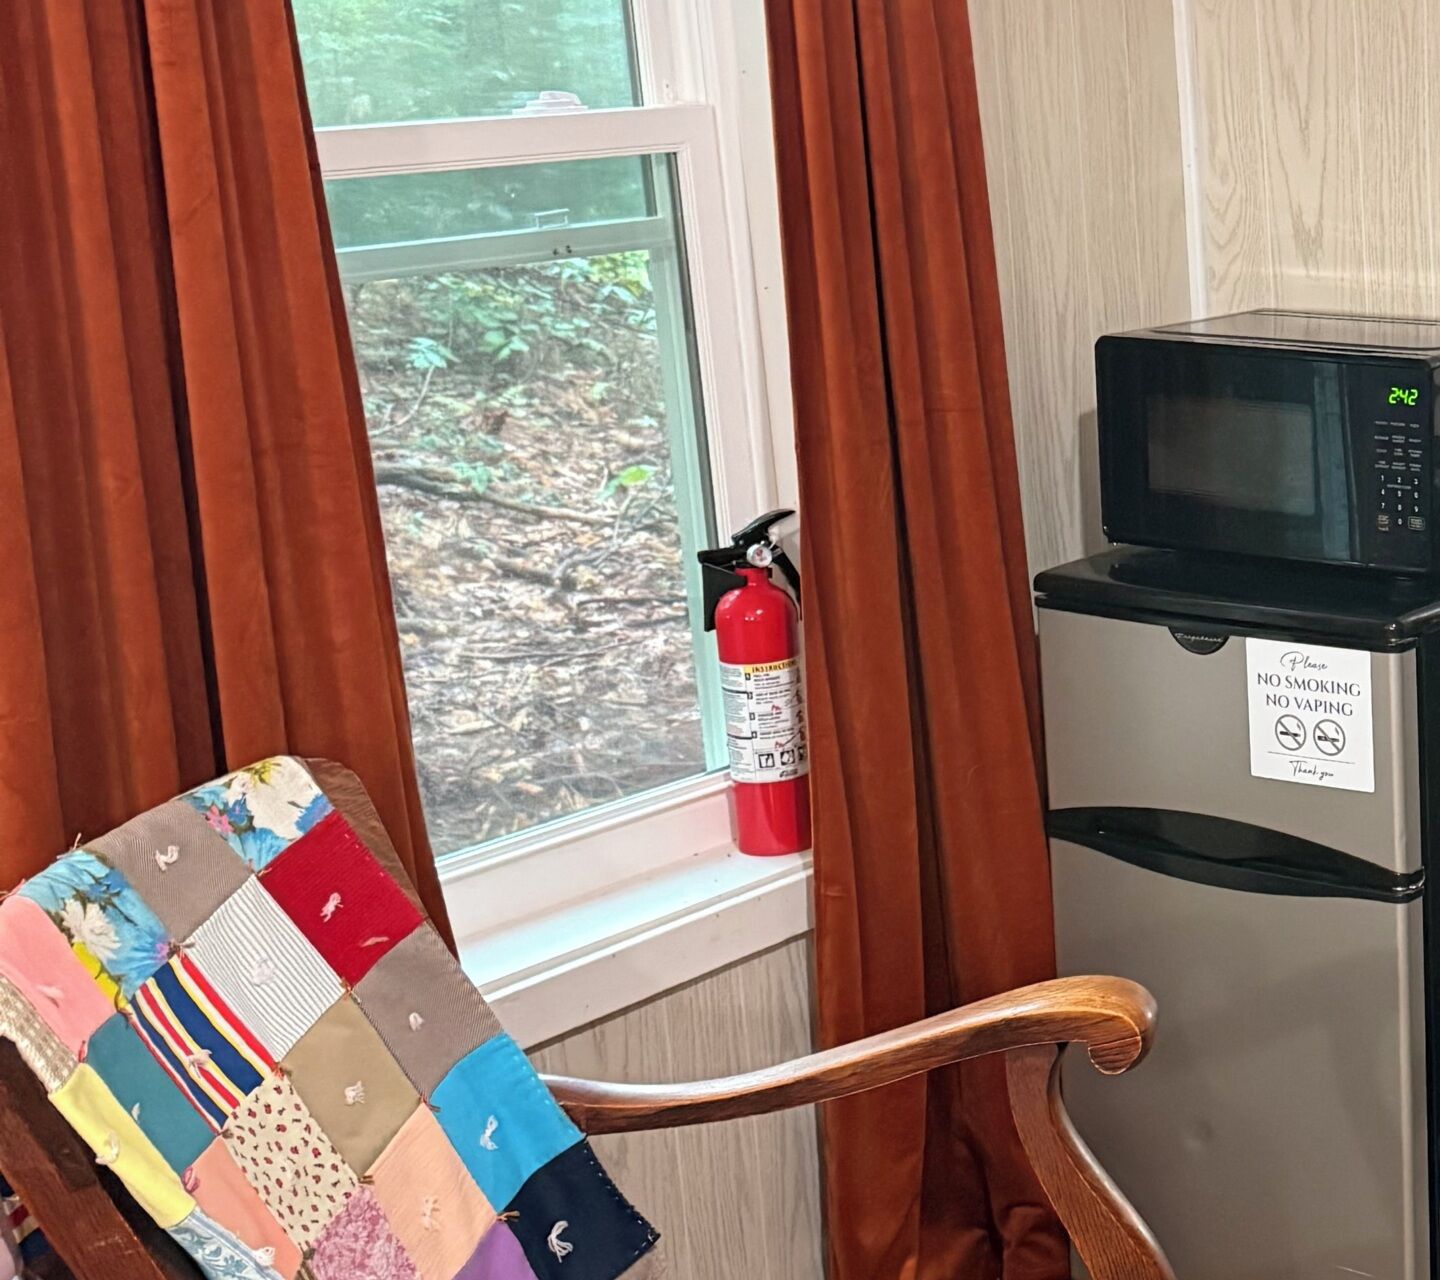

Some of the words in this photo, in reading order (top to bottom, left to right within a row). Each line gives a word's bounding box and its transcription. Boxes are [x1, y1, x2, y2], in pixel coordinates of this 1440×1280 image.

[1388, 387, 1419, 406] 2:42
[1280, 651, 1328, 671] Please
[1257, 672, 1281, 688] NO
[1284, 675, 1361, 697] SMOKING
[1266, 693, 1290, 709] NO
[1294, 696, 1354, 717] VAPING
[1289, 760, 1318, 776] Thank
[1318, 771, 1335, 781] you
